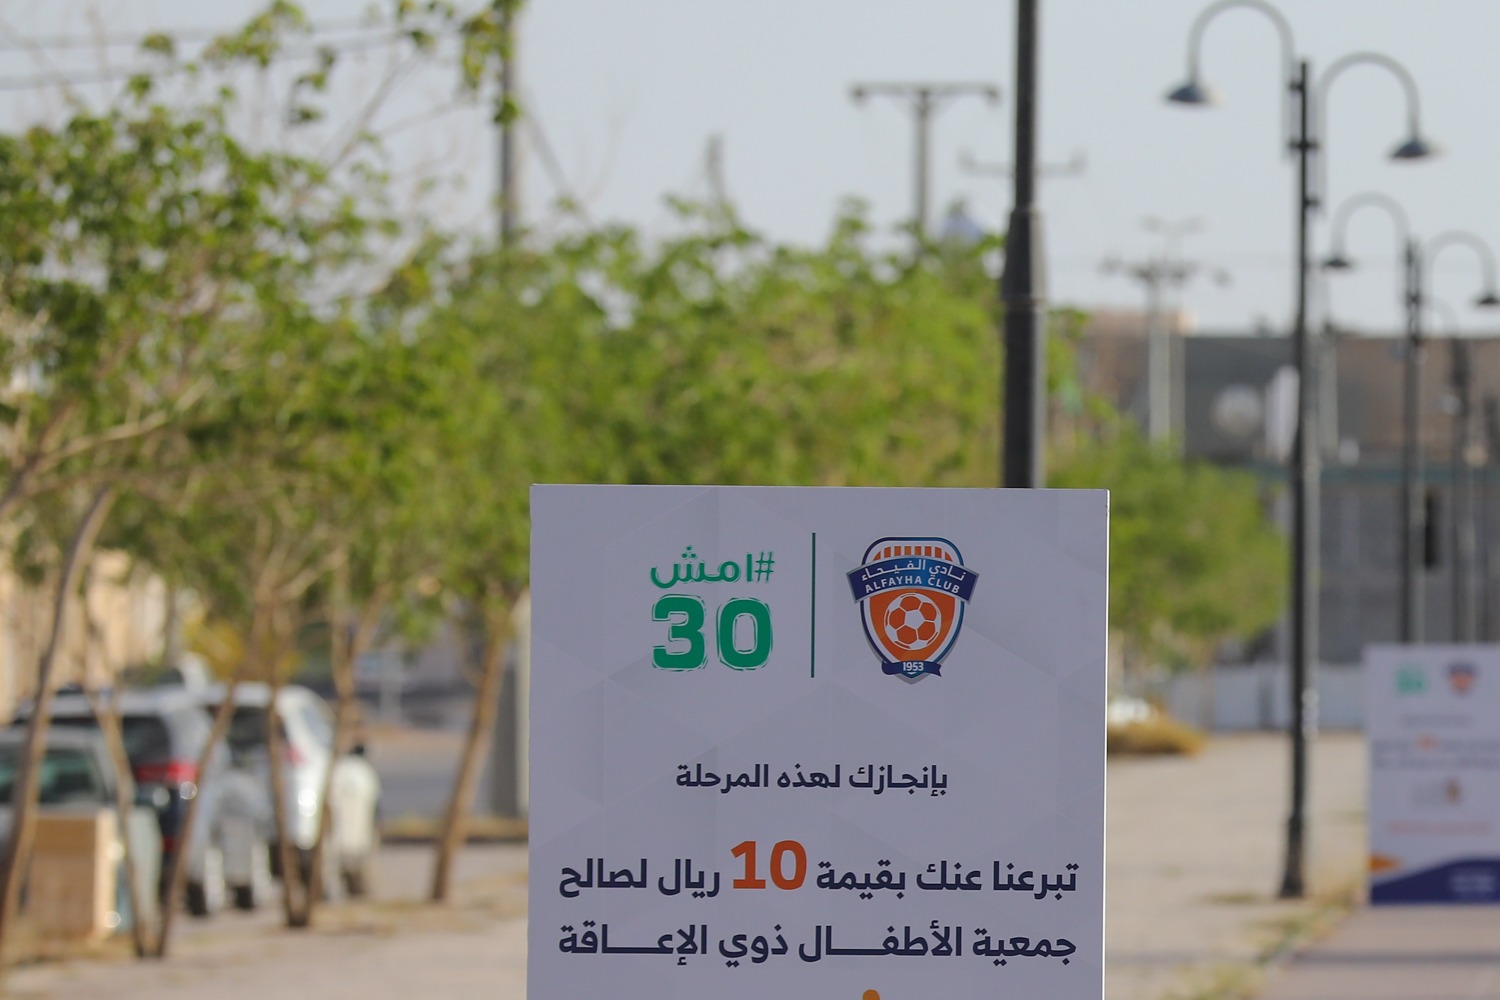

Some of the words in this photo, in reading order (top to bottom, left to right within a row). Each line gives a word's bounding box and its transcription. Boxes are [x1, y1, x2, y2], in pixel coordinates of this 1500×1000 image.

[865, 575, 922, 593] ALFAYHA
[927, 577, 960, 594] CLUB
[929, 565, 966, 582] نادي
[652, 594, 773, 672] 30
[902, 661, 924, 672] 1953
[676, 763, 769, 794] المرحلة
[776, 763, 841, 788] لهذه
[848, 764, 948, 797] بإنجازك
[559, 858, 648, 898] لصالح
[657, 858, 721, 899] ريال
[730, 840, 808, 891] 10
[816, 859, 906, 900] بقيمة
[916, 860, 982, 891] عنك
[993, 860, 1079, 900] تبرعنا
[558, 920, 708, 966] الإعاقة
[718, 924, 789, 968] ذوي
[798, 919, 963, 963] الأطفال
[972, 927, 1077, 967] جمعية
